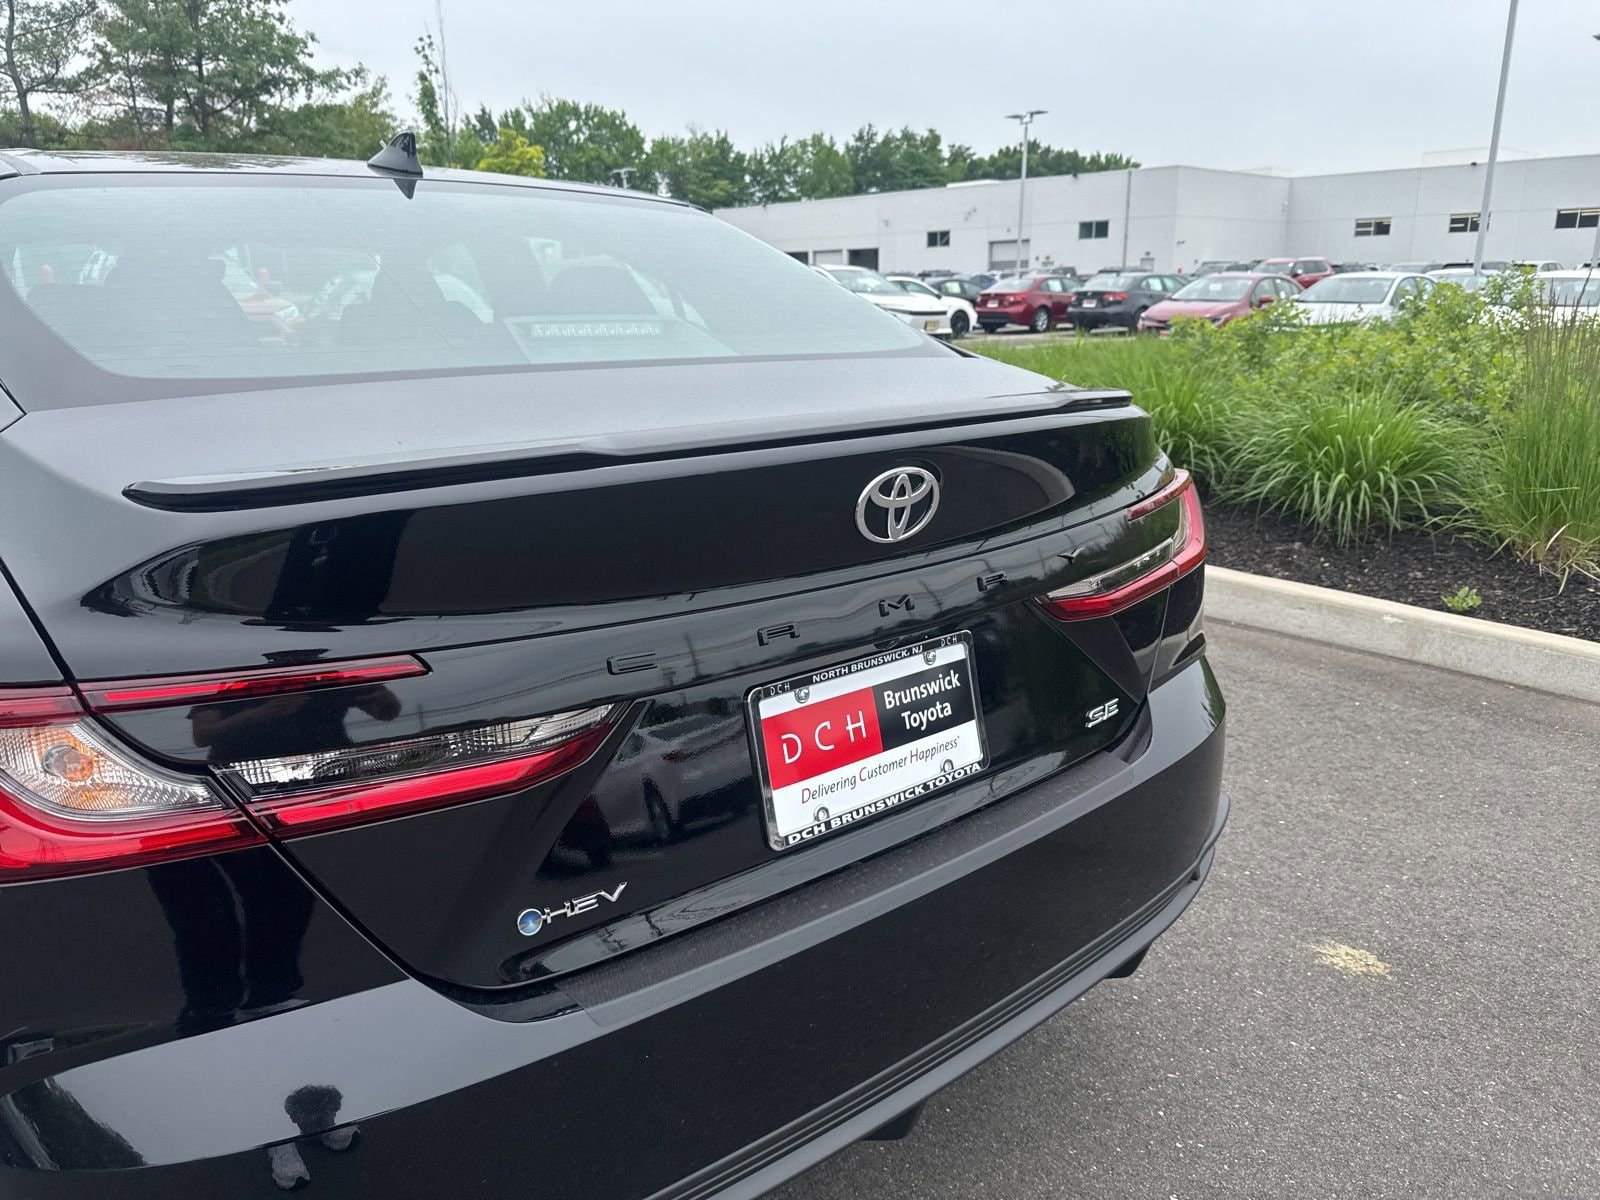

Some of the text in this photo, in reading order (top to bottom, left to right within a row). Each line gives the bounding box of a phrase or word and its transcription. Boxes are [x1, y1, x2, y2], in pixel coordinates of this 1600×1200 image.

[606, 546, 1084, 676] CAMRY
[812, 645, 923, 683] NORTH BRUNSWICK, NJ
[883, 669, 961, 710] Brunswick
[901, 701, 952, 731] Toyota
[1085, 697, 1120, 728] SE
[801, 773, 857, 804] Delivering
[859, 755, 907, 782] Customer
[788, 762, 982, 845] DCH BRUNSWICK TOYOTA
[542, 881, 628, 924] HEV
